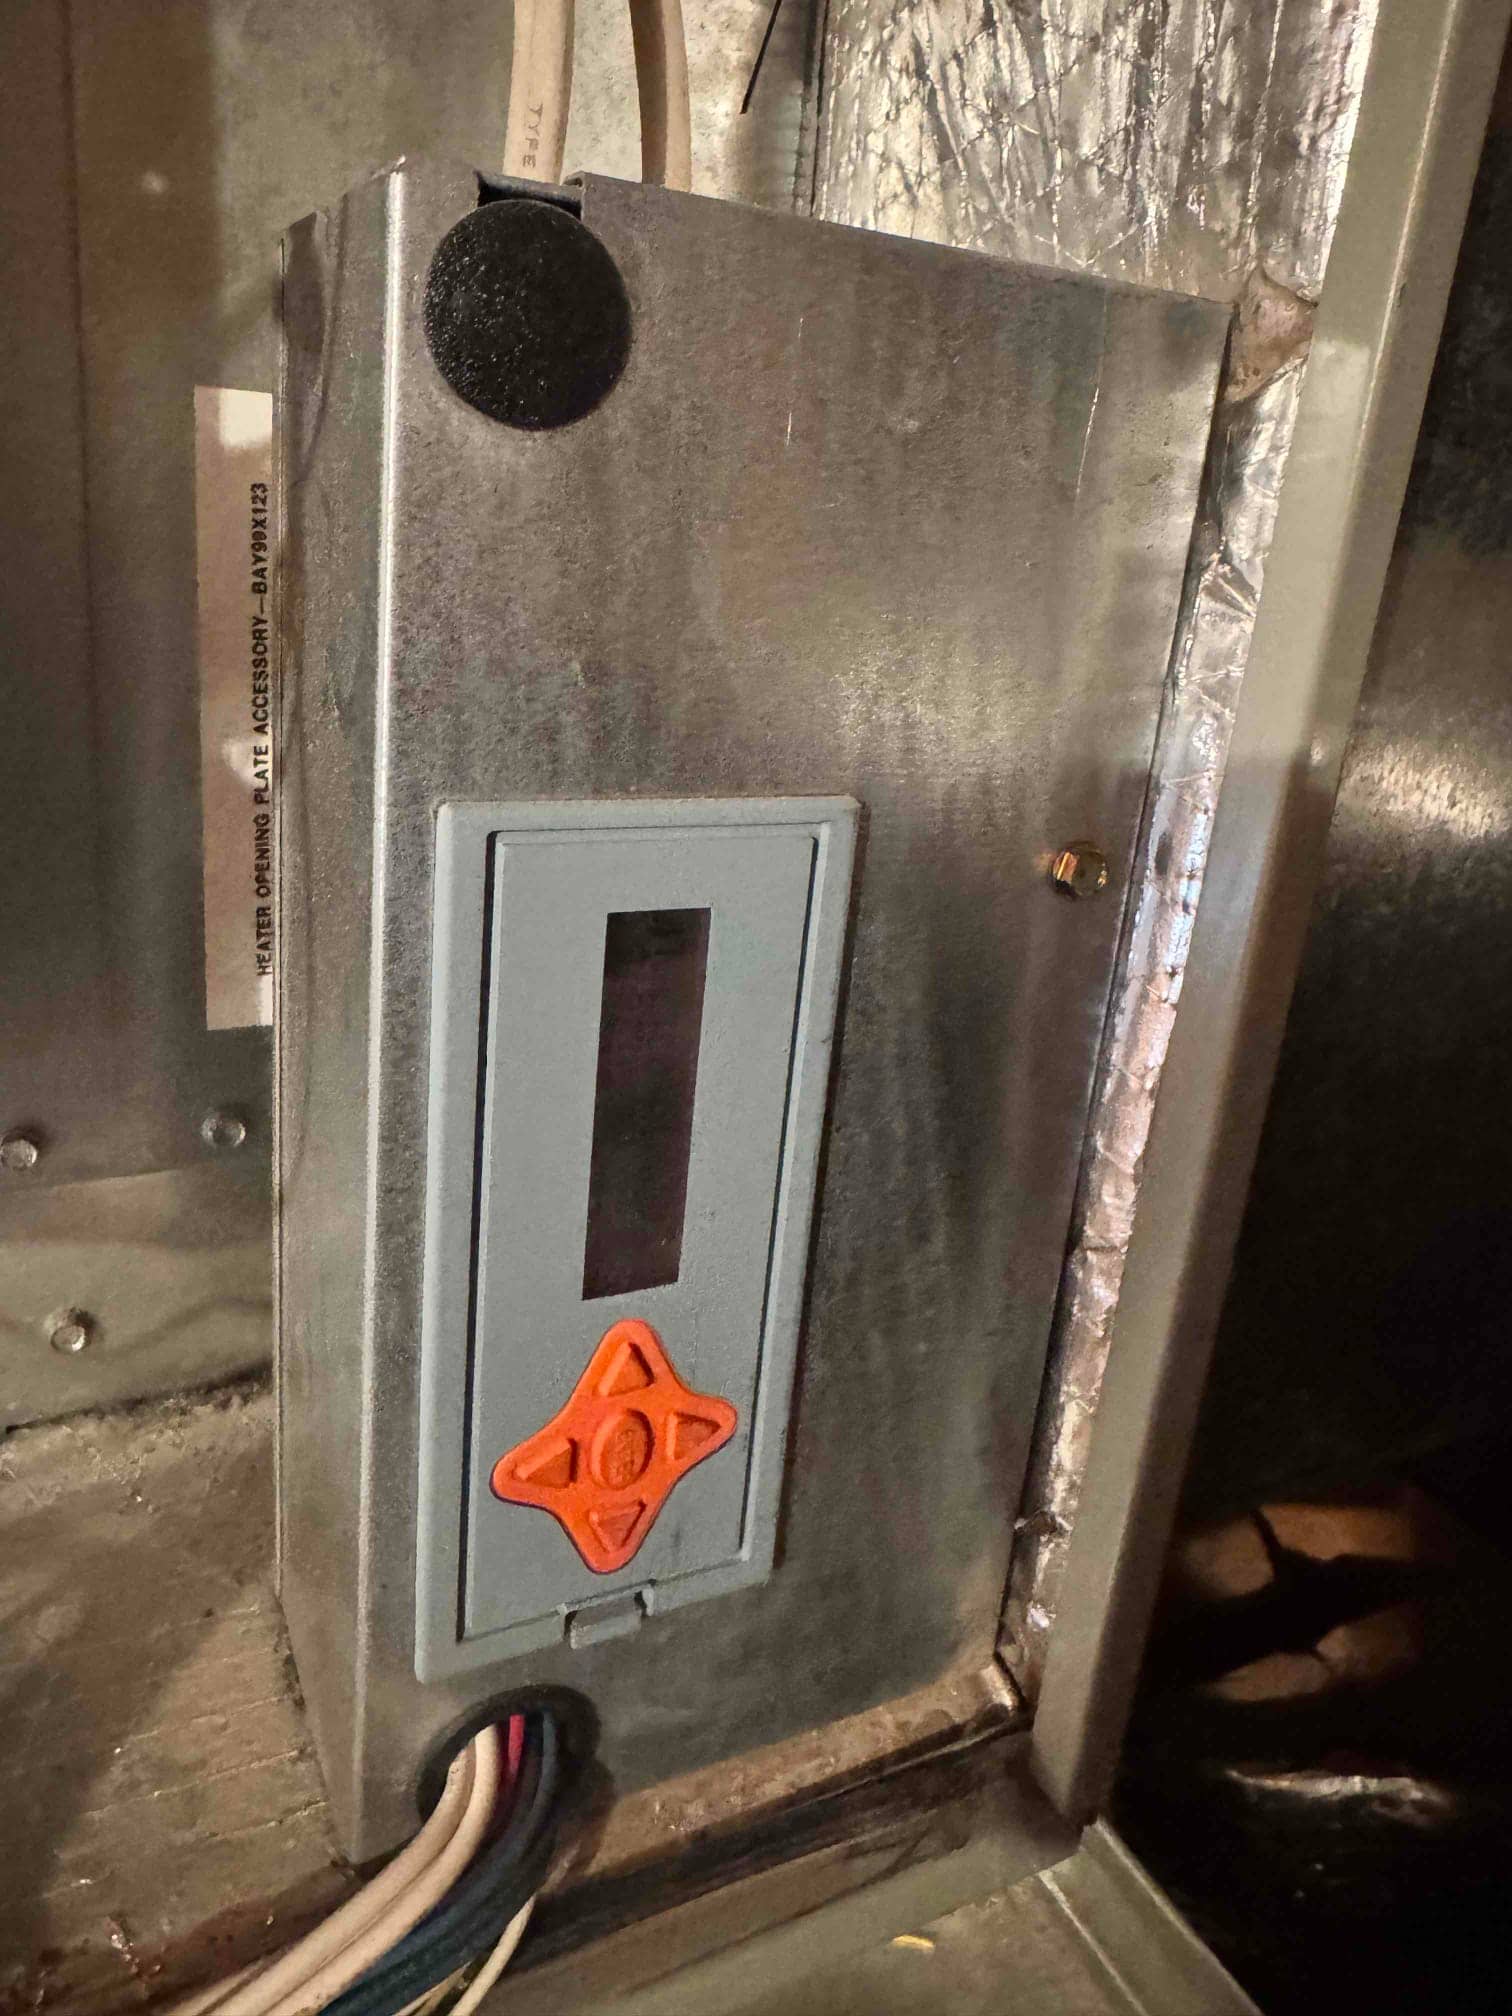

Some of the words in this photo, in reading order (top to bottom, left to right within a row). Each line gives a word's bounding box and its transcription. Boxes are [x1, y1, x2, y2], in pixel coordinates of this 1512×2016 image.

[253, 744, 270, 808] PLATE
[253, 814, 272, 898] OPENING
[255, 907, 273, 976] HEATER
